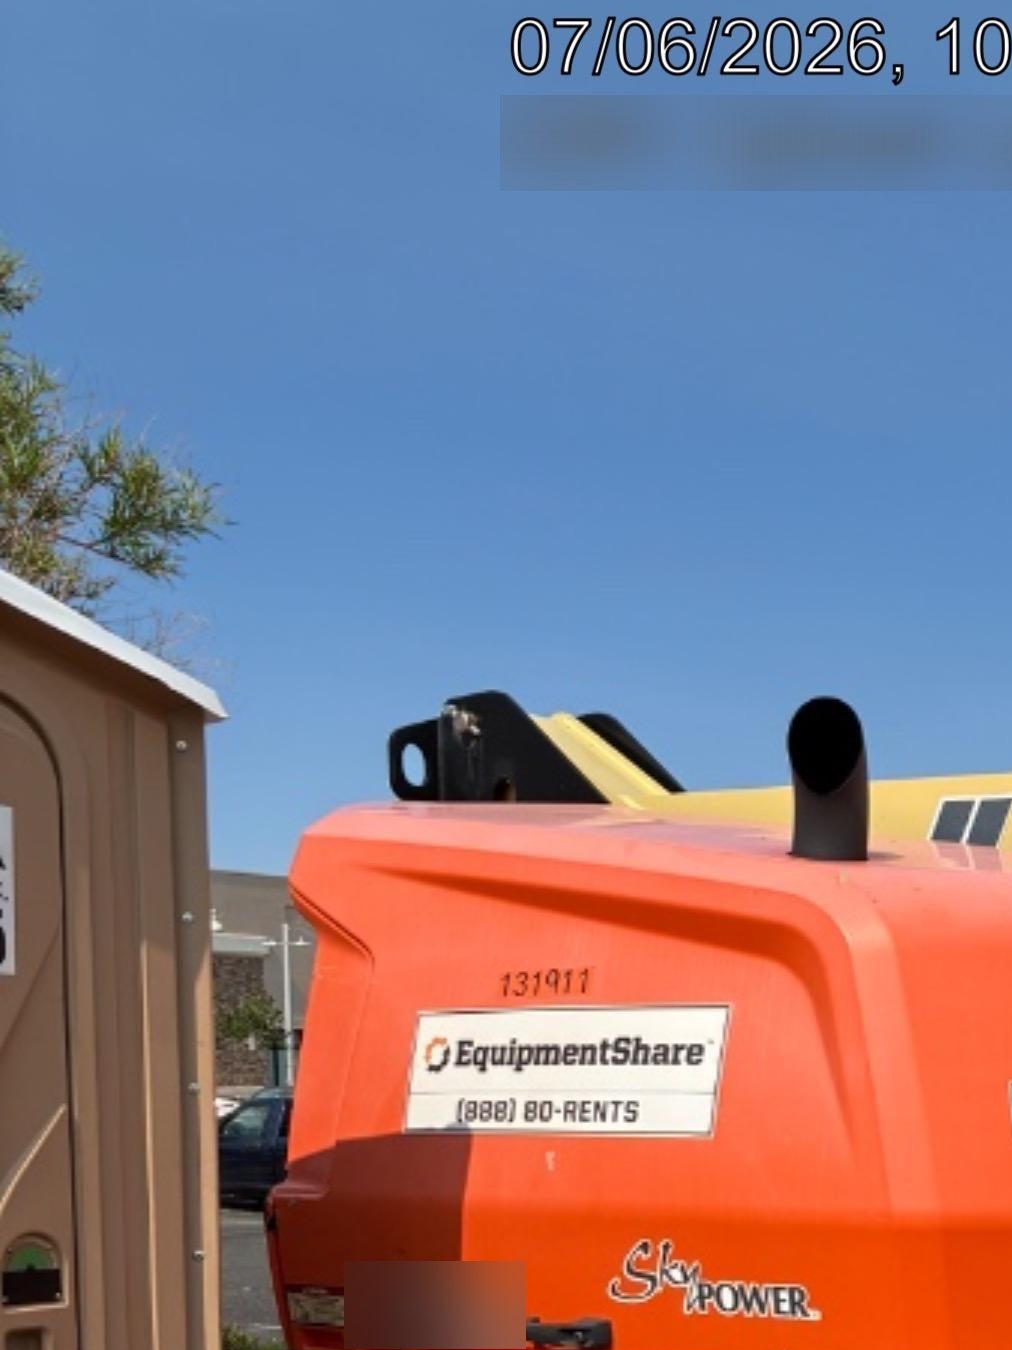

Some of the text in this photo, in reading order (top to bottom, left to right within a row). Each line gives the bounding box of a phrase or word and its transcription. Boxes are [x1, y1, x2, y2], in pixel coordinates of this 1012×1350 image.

[501, 968, 590, 997] 131911
[454, 1036, 705, 1072] EquipmentShare
[456, 1098, 640, 1123] (888) 80-RENTS
